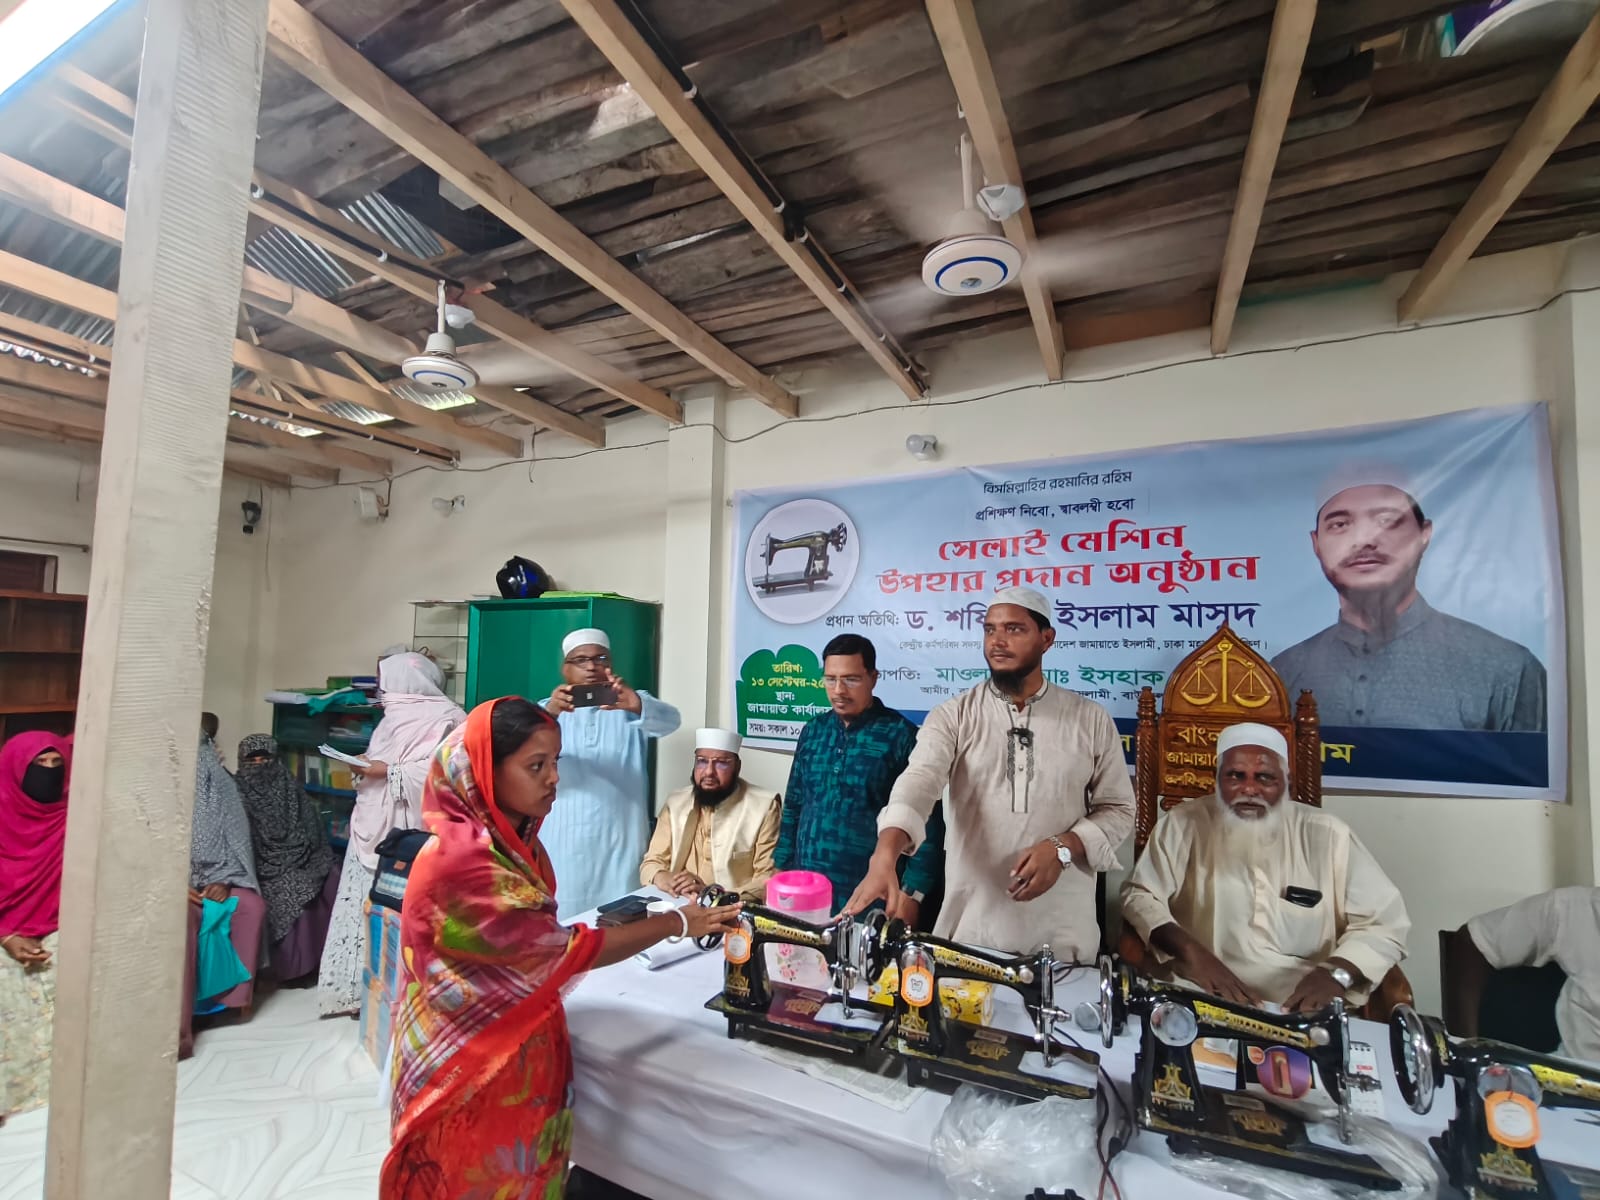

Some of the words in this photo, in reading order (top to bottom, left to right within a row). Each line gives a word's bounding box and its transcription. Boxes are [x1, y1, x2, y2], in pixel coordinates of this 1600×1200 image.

[1049, 472, 1099, 490] রহমানির
[1101, 469, 1133, 485] রহিম
[975, 506, 1016, 521] প্রশিক্ষণ
[1105, 498, 1136, 511] হবো
[938, 528, 1050, 561] সেলাই
[1061, 518, 1187, 553] মেশিন
[875, 568, 988, 594] উপহার
[1104, 549, 1261, 594] অনুষ্ঠান
[825, 614, 855, 628] প্রধান
[904, 611, 934, 631] ড.
[1053, 599, 1160, 631] ইসলাম
[1077, 664, 1166, 686] ইসহাক
